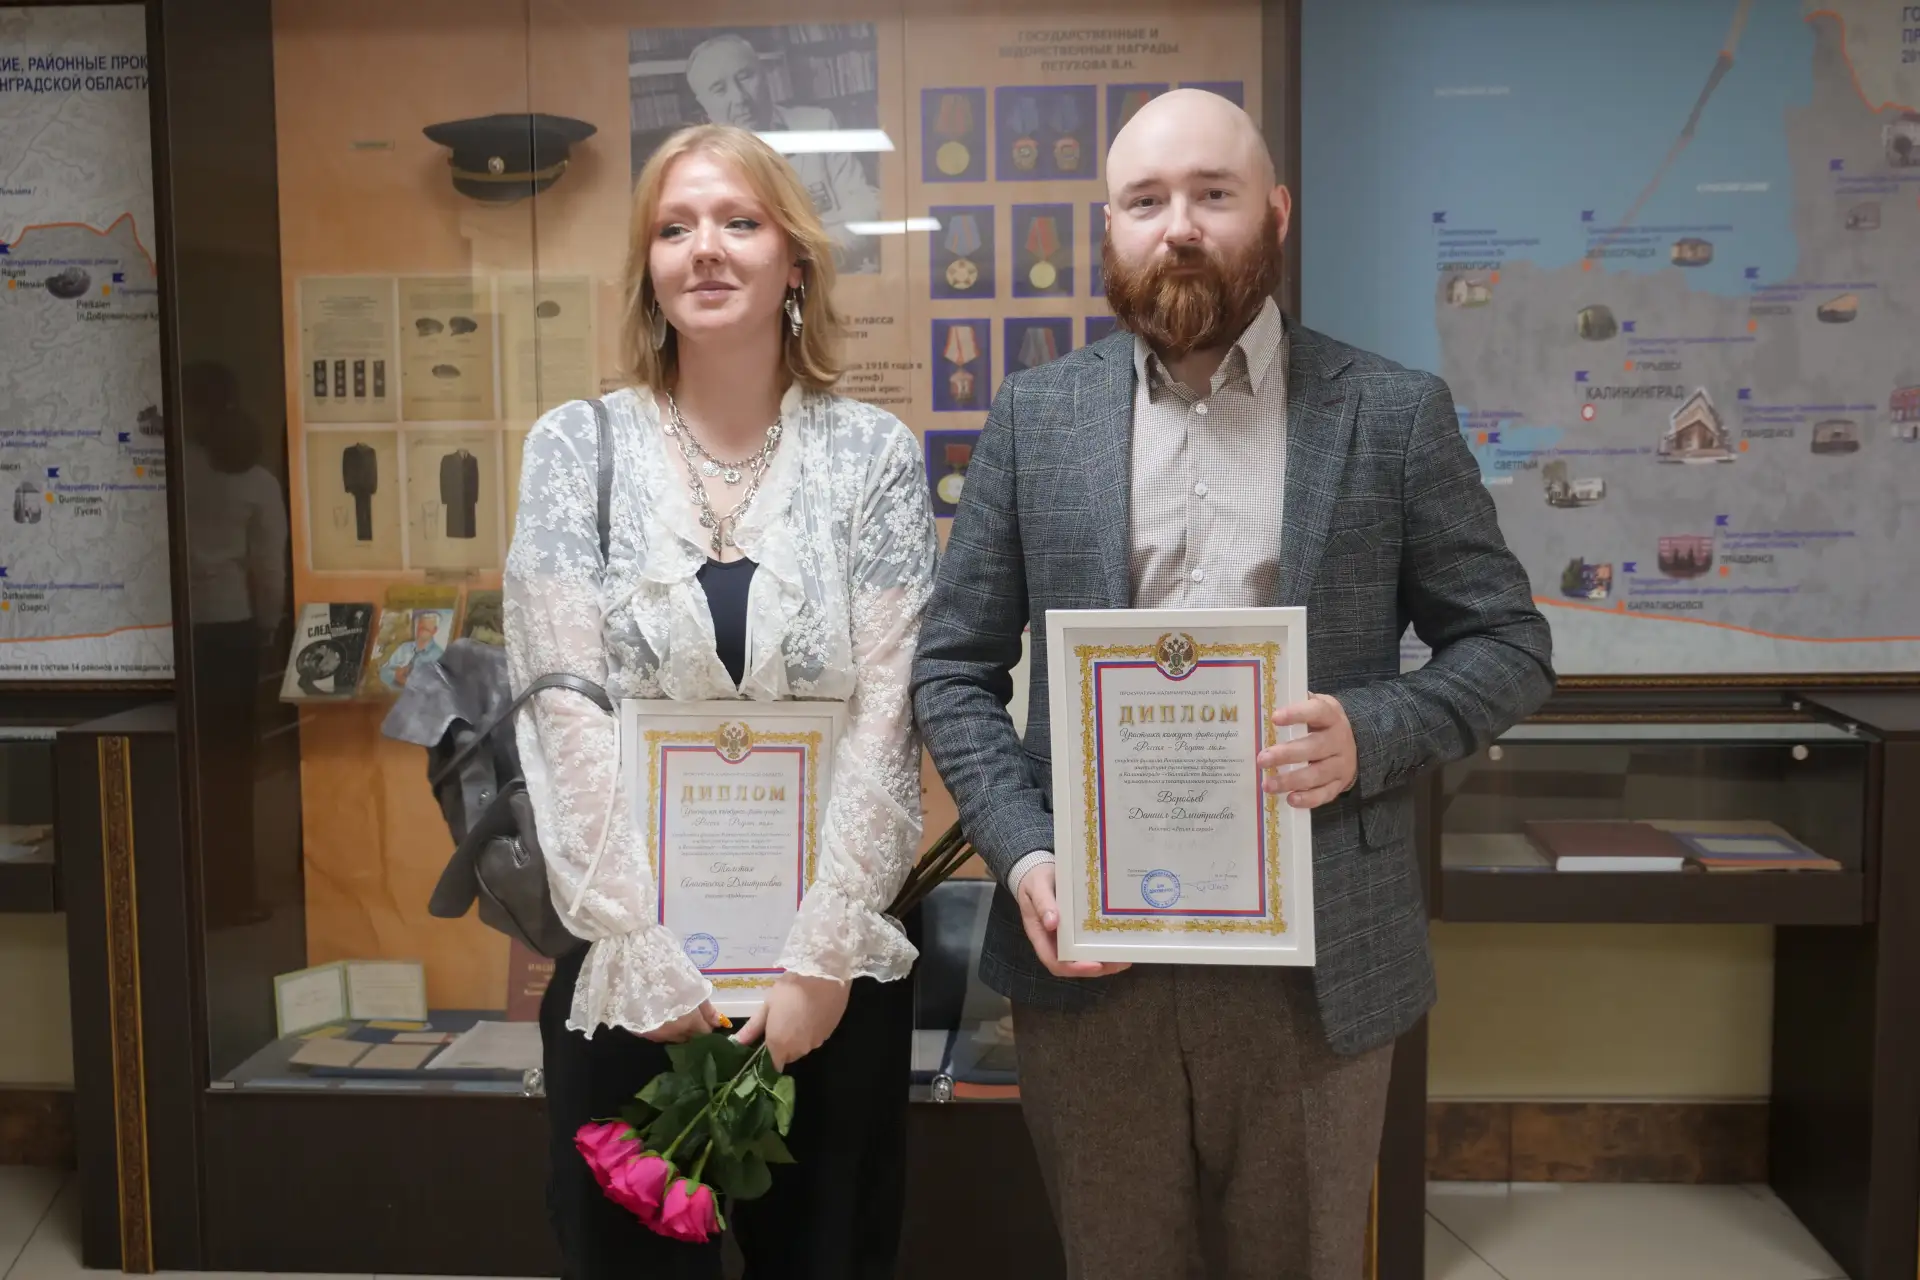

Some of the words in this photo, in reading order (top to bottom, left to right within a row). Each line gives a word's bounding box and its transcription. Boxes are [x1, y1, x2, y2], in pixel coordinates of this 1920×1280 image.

[28, 53, 107, 71] РАЙОННЫЕ
[1586, 387, 1685, 400] КАЛИНИНГРАД
[1118, 704, 1239, 727] ДИПЛОМ
[681, 785, 786, 805] ДИПЛОМ
[1157, 790, 1208, 806] Воробьев
